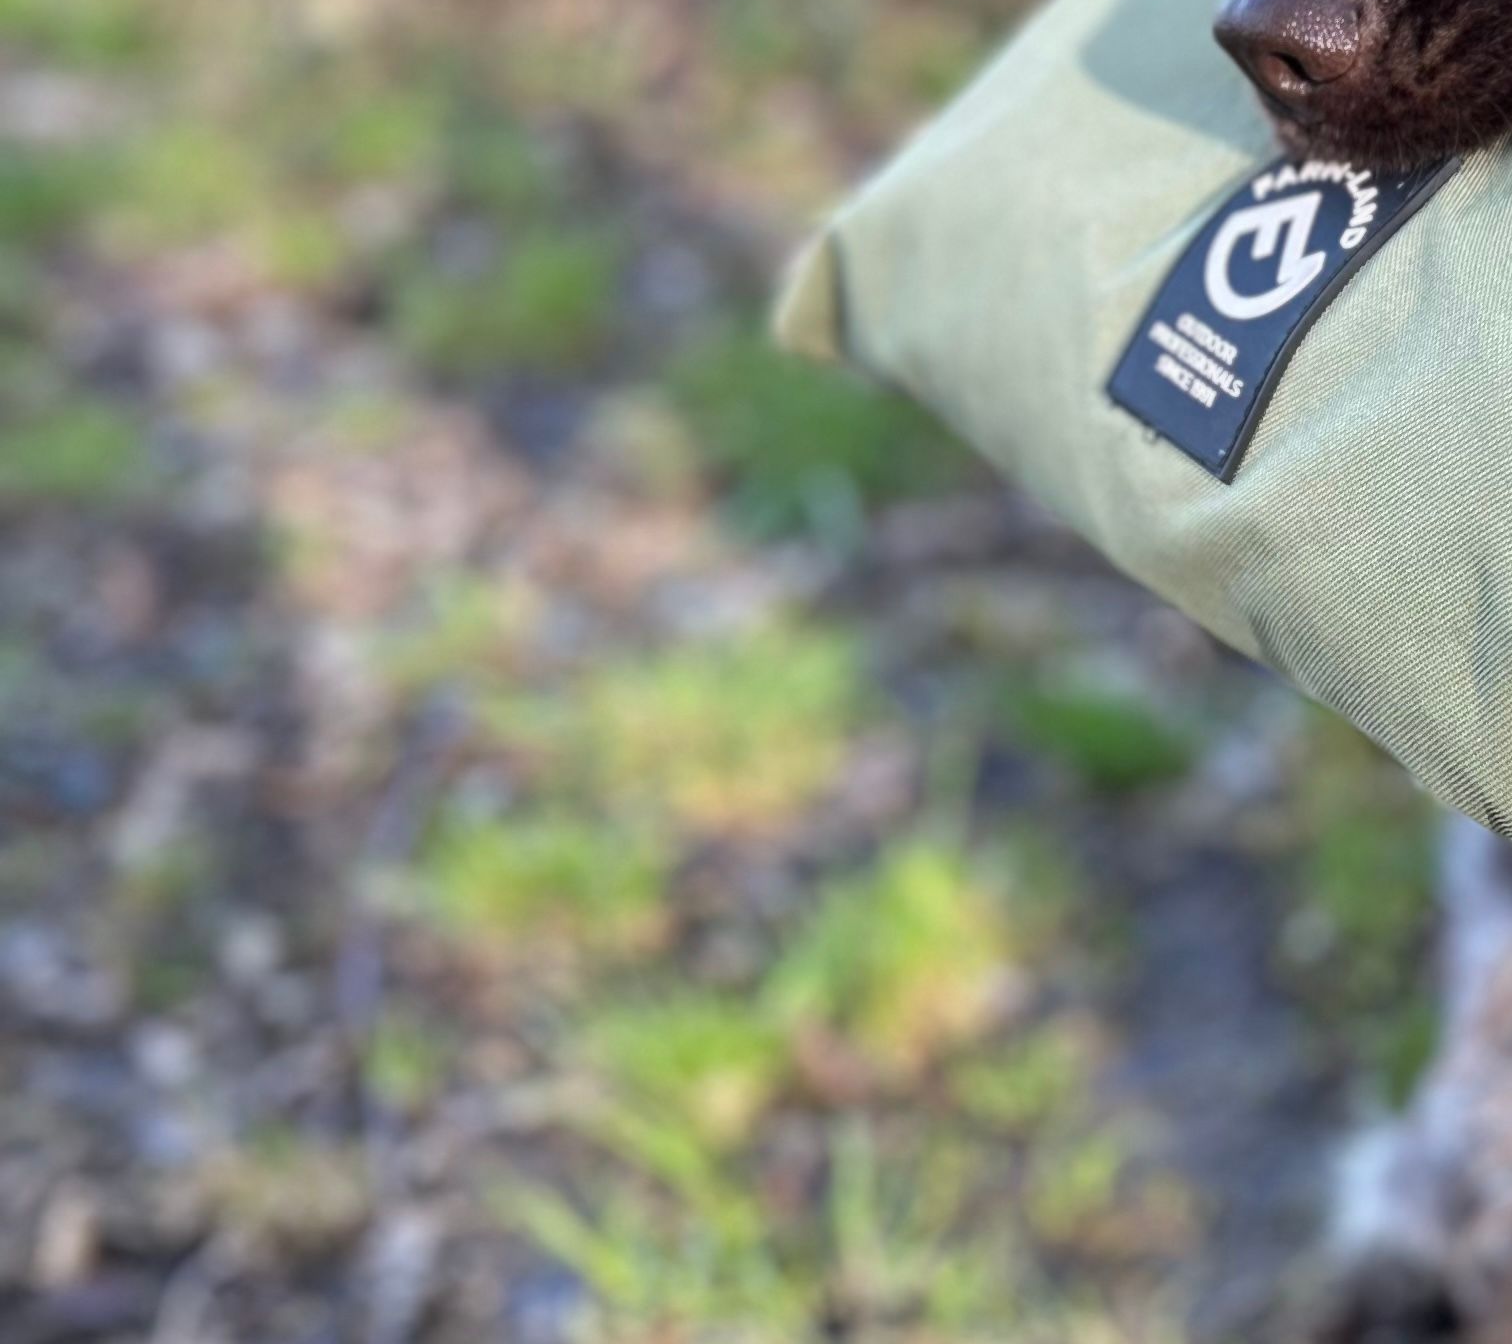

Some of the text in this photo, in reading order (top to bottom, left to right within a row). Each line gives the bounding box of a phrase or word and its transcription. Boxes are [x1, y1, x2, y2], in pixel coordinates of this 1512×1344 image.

[1148, 320, 1244, 398] PROFESSIONALS
[1176, 312, 1238, 366] OUTDOOR
[1154, 353, 1194, 391] SINCE
